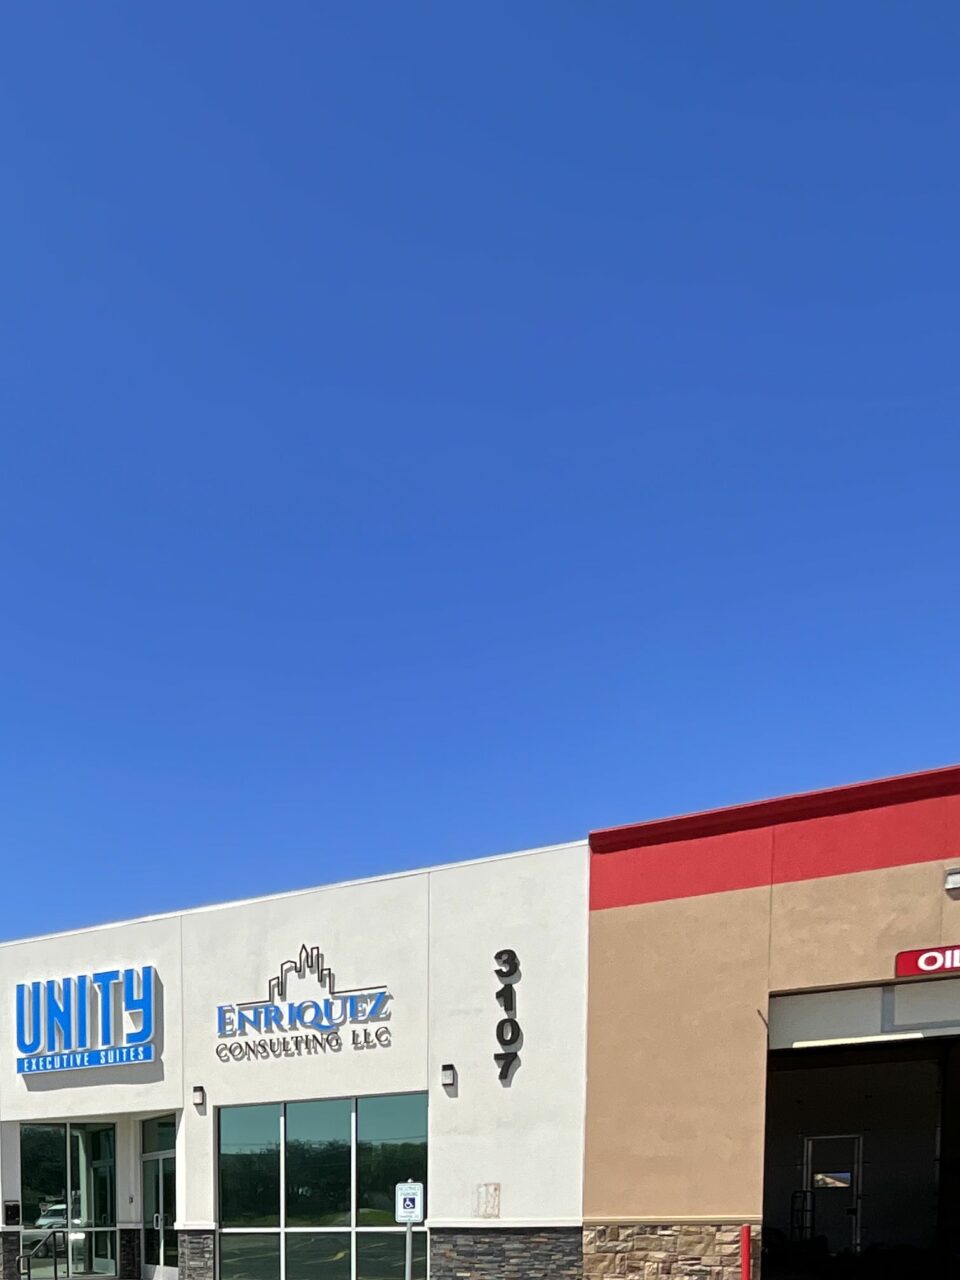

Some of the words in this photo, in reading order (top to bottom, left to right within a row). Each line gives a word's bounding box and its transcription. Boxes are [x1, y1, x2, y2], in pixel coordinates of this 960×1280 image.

[16, 966, 154, 1055] UNITY
[217, 991, 390, 1035] ENRIQUEZ
[494, 949, 520, 1080] 3107
[24, 1053, 89, 1072] EXECUTIVE
[100, 1047, 144, 1065] SUITES
[216, 1032, 340, 1059] CONSULTING
[352, 1027, 390, 1046] LLC
